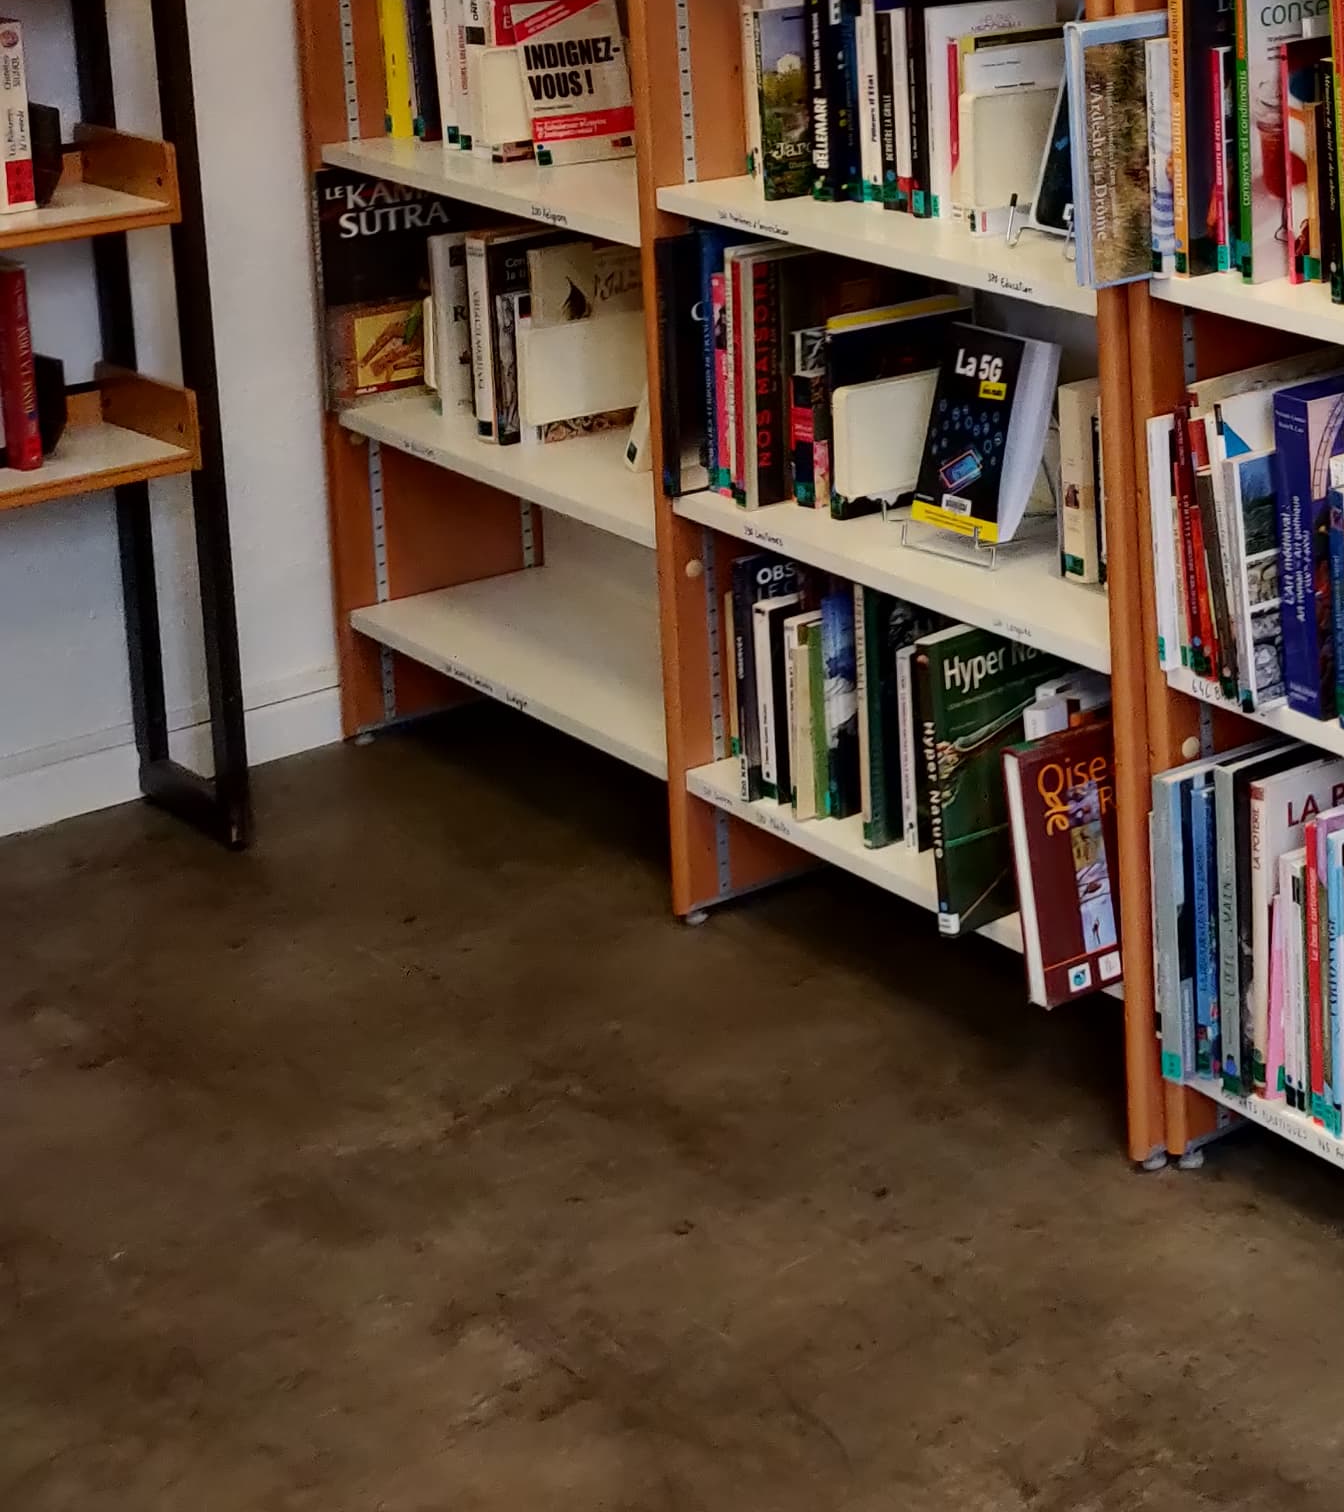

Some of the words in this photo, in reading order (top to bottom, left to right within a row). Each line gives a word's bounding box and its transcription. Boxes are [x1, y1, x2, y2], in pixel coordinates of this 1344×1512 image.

[524, 36, 621, 71] INDIGNEZ-
[528, 74, 581, 101] VOUS
[813, 96, 829, 170] BELLEMARE
[752, 262, 770, 395] MAISONS
[955, 349, 976, 375] La
[978, 353, 1004, 382] 5G
[943, 645, 1008, 693] Hyper
[1288, 799, 1321, 828] LA
